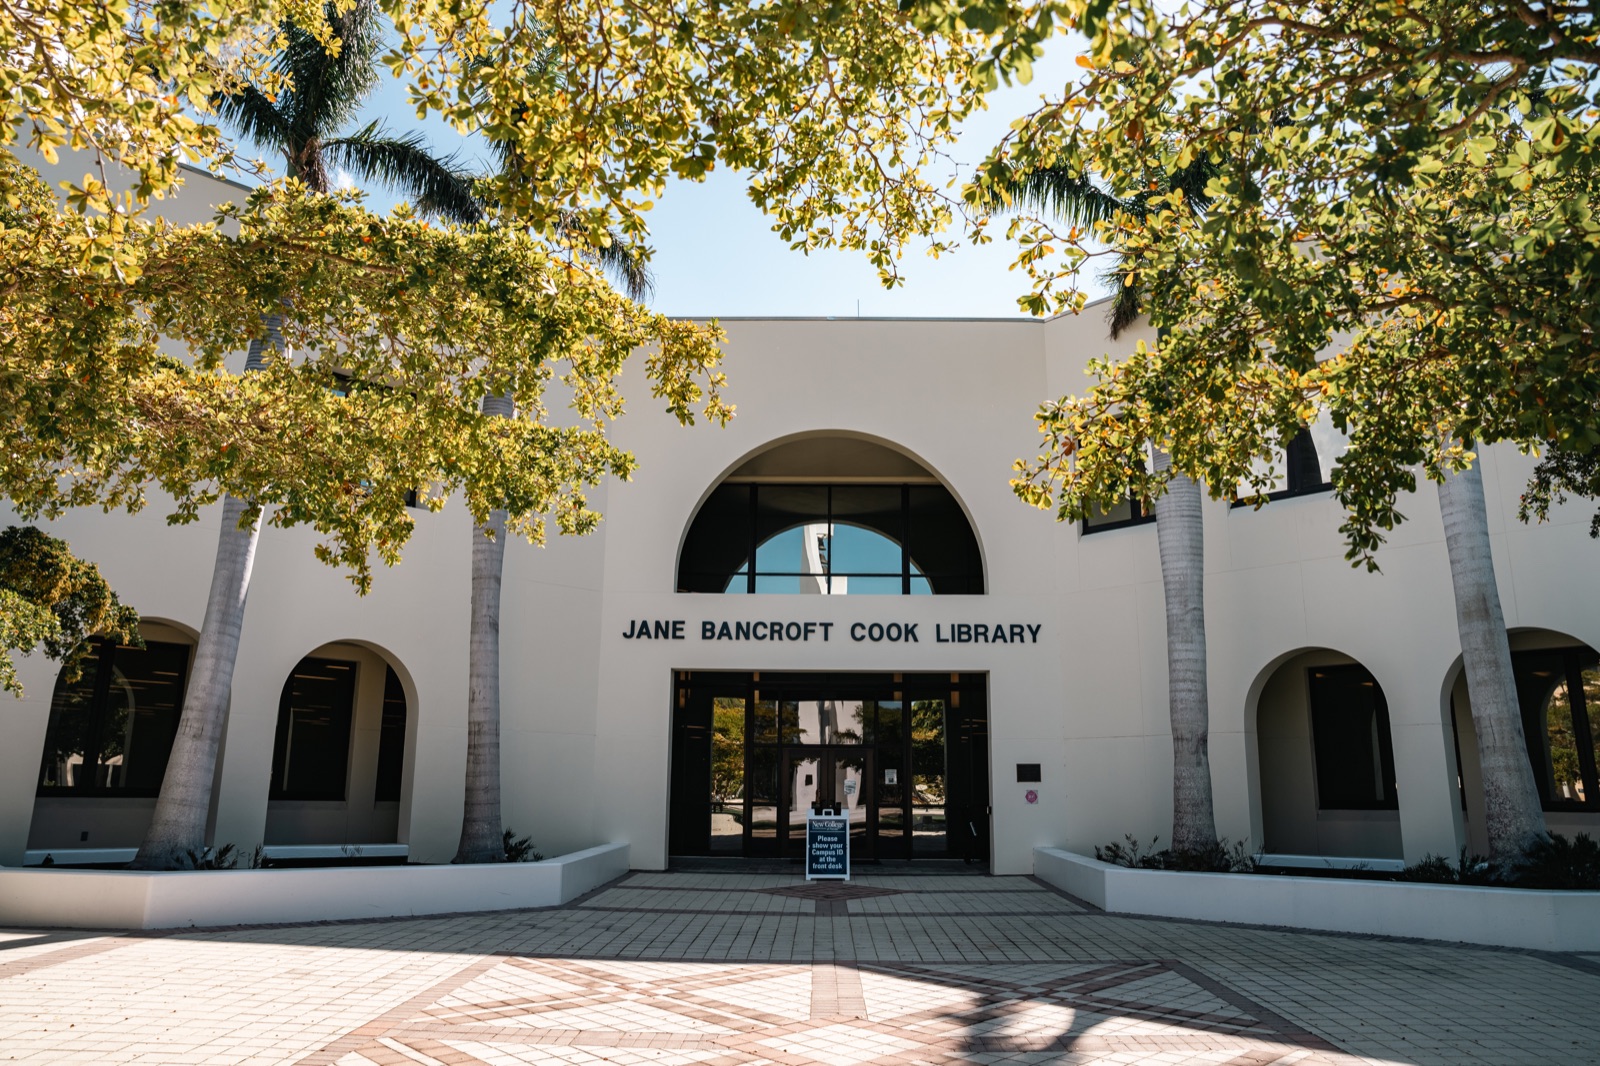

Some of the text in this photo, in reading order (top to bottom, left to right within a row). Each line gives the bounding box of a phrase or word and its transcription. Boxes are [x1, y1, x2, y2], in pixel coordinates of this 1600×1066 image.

[622, 619, 1042, 644] JANE BANCROFT COOK LIBRARY
[824, 821, 844, 829] College
[811, 849, 836, 857] Campus
